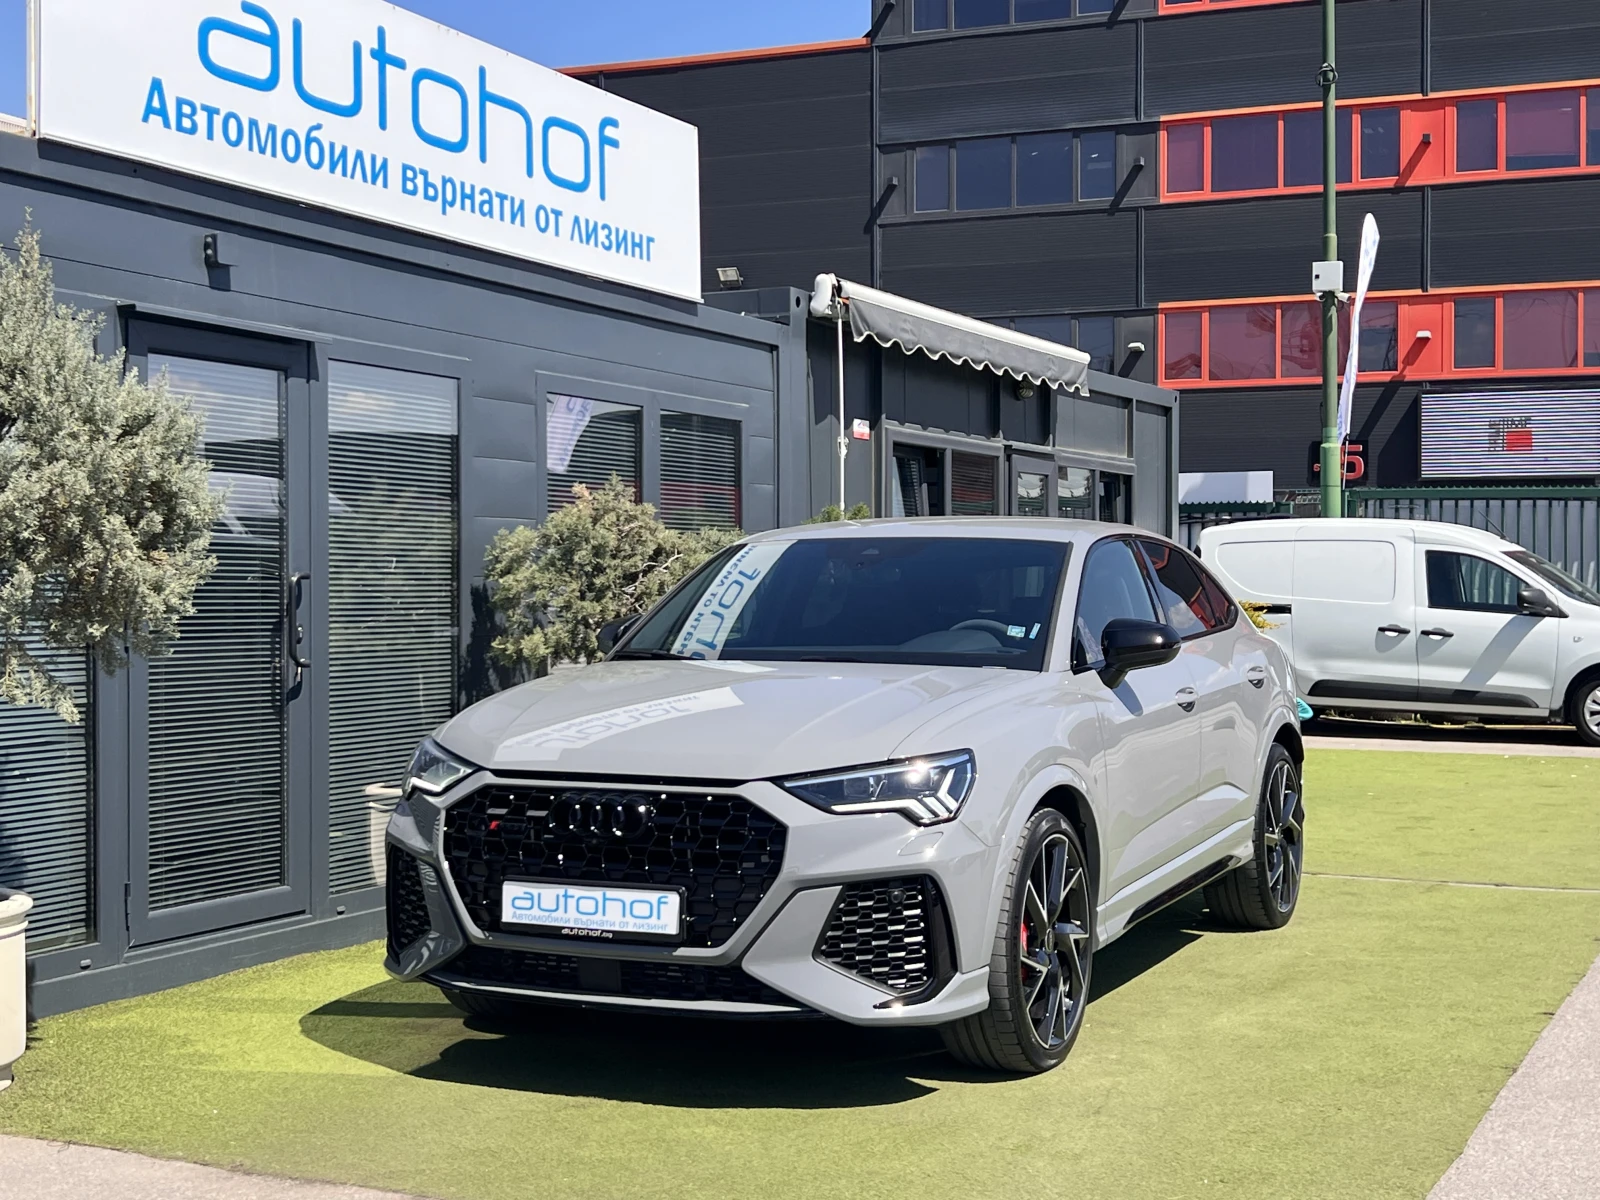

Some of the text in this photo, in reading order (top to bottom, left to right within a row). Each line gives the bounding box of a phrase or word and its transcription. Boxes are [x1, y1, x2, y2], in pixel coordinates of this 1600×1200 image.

[198, 1, 619, 200] autohof
[142, 78, 654, 260] Автомобили върнати от лизинг
[511, 888, 669, 921] autohof
[512, 911, 668, 931] Автомобили върнати от лизинг
